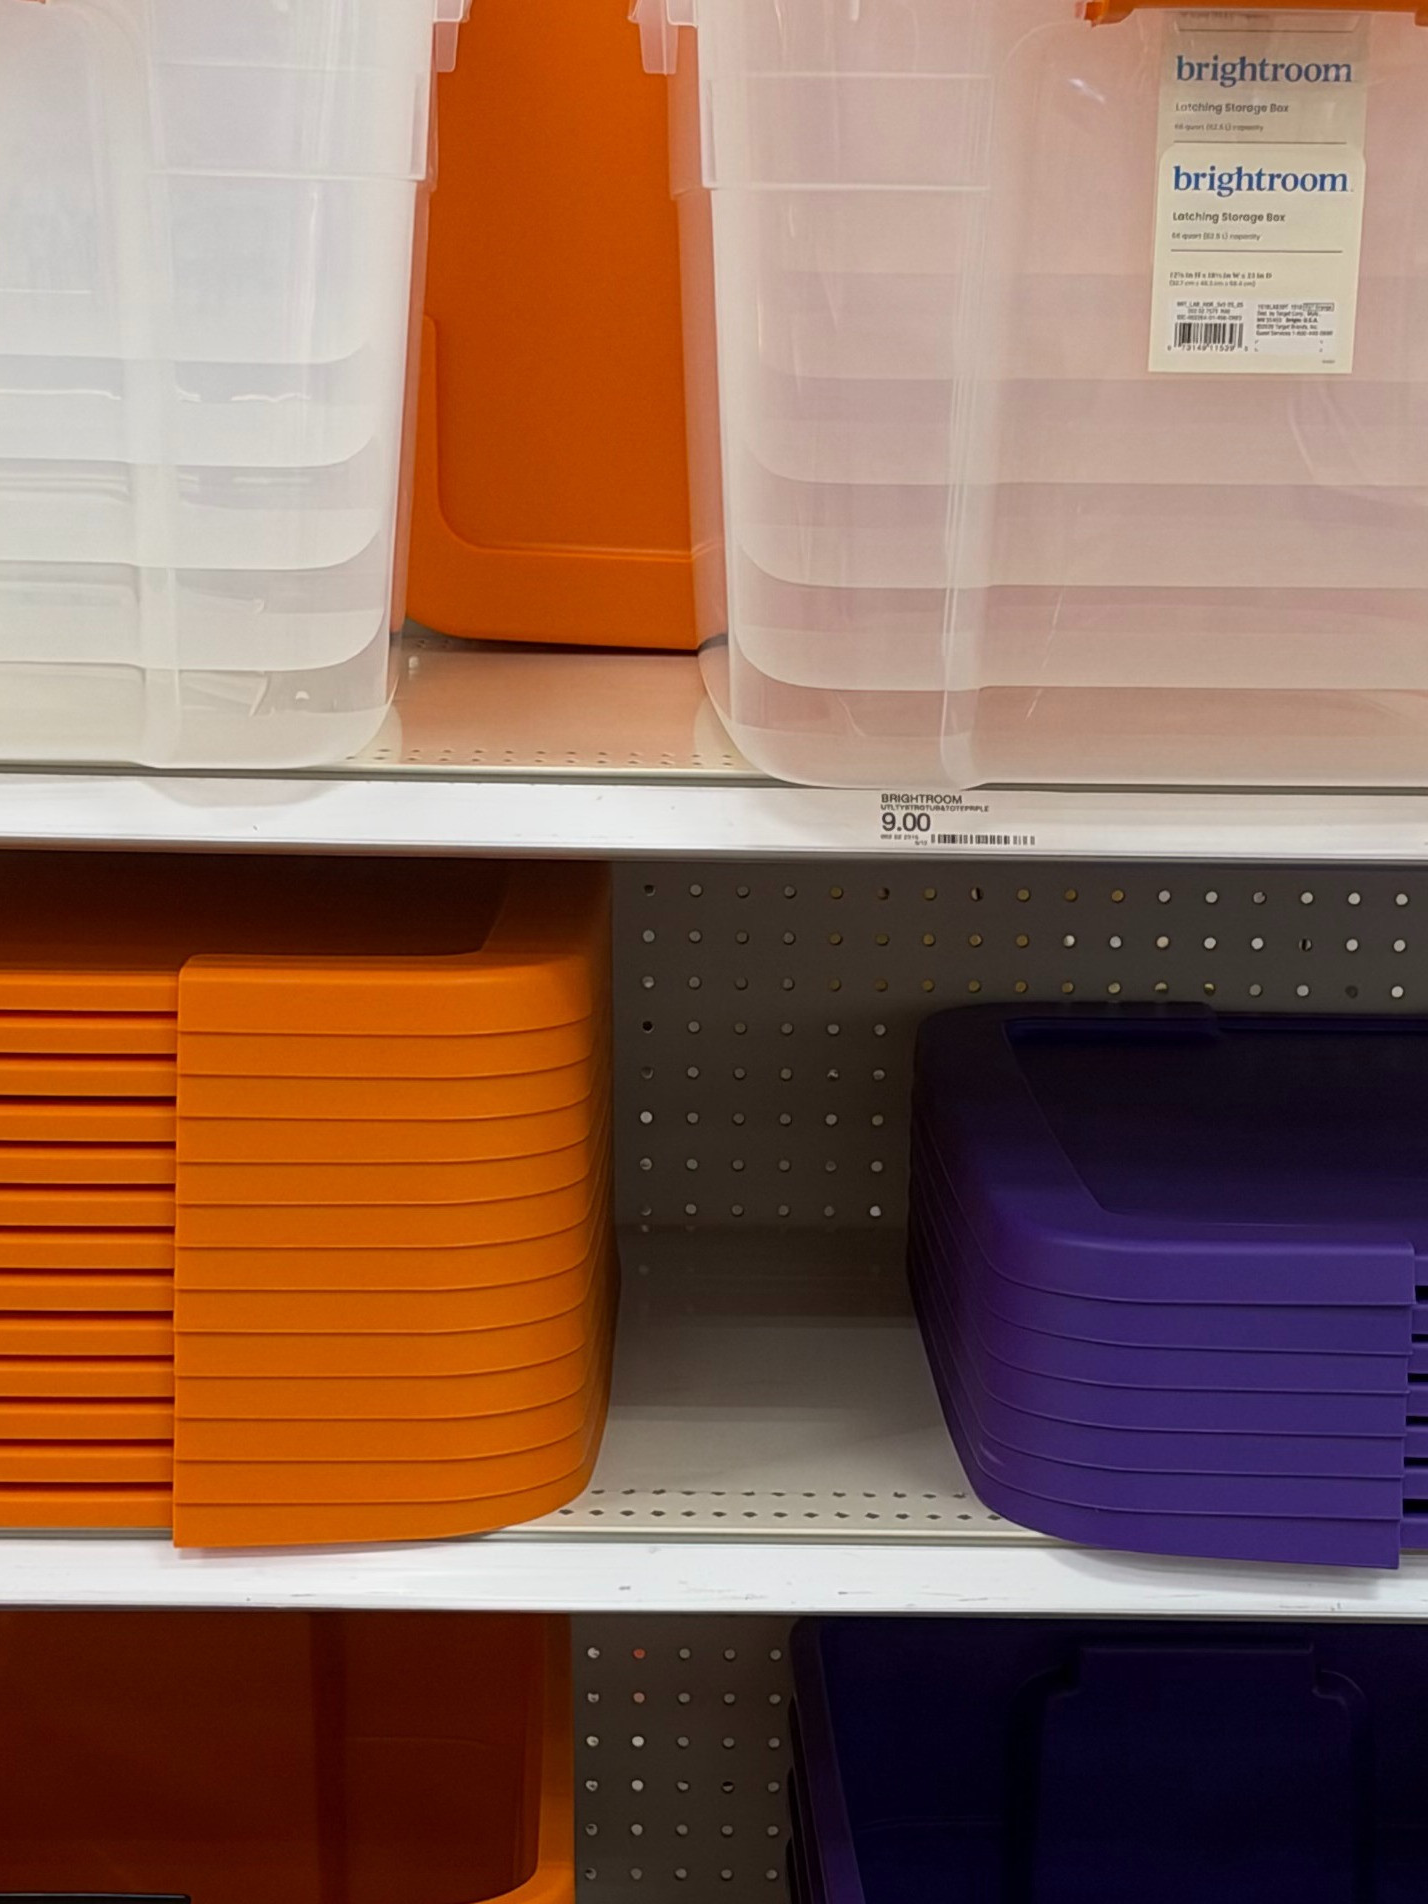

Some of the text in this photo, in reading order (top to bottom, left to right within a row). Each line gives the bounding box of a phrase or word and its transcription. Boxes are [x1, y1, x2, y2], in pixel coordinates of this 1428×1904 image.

[1176, 54, 1353, 88] brightroom
[1175, 102, 1289, 115] Latching Storage Box
[1173, 165, 1348, 197] brightroom
[1172, 212, 1286, 225] Latching Storage Box
[881, 793, 963, 804] BRIGHTROOM
[881, 812, 931, 832] 9.00
